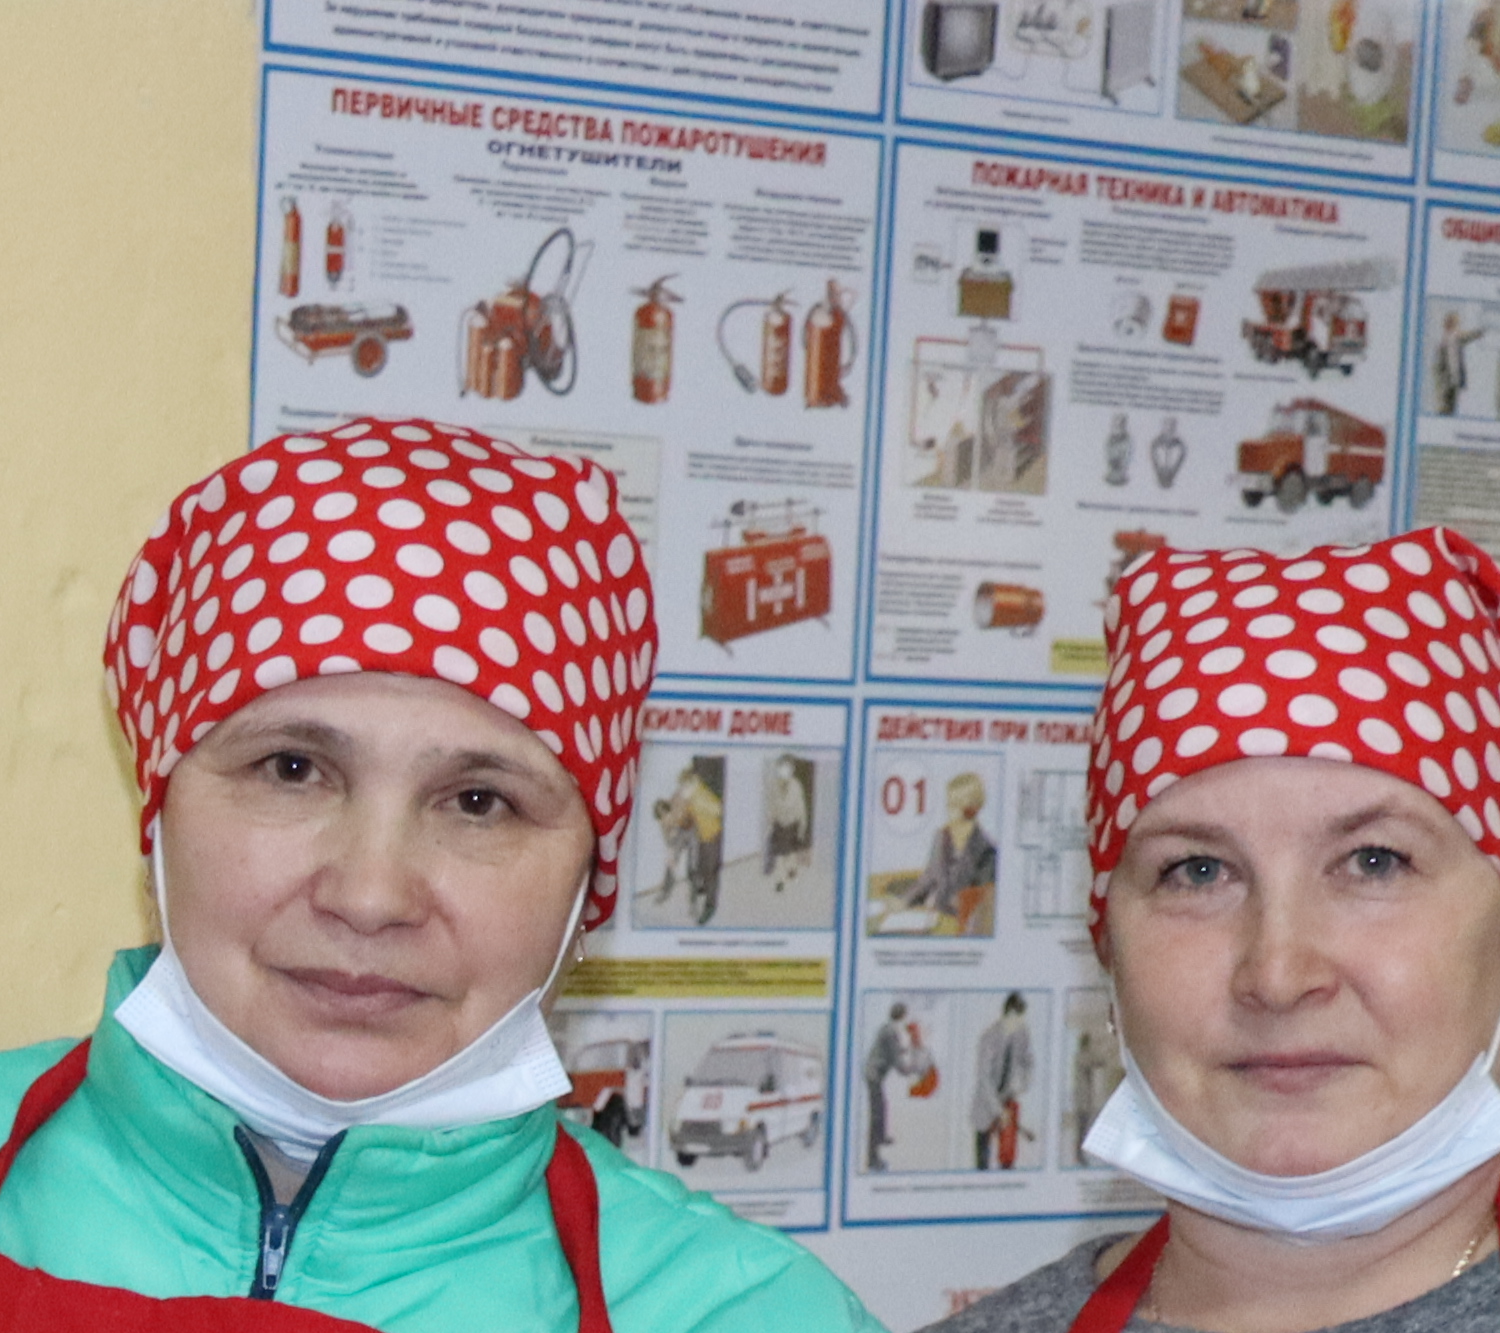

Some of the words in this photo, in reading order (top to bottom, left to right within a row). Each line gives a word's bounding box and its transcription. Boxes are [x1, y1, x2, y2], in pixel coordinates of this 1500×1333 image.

[331, 87, 484, 129] ПЕРВИЧНЫЕ
[492, 105, 614, 142] СРЕДСТВА
[621, 120, 828, 166] ПОЖАРОТУШЕНИЯ
[487, 139, 682, 173] ОГНЕТУШИТЕЛИ
[971, 159, 1088, 196] ПОЖАРНАЯ
[1097, 174, 1184, 206] ТЕХНИКА
[1211, 189, 1340, 224] АВТОМАТИКА
[728, 709, 792, 736] ДОМЕ
[877, 712, 984, 741] ДЕЙСТВИЯ
[988, 719, 1028, 742] ПРИ
[1033, 720, 1096, 744] ПОЖА
[881, 775, 926, 816] 01
